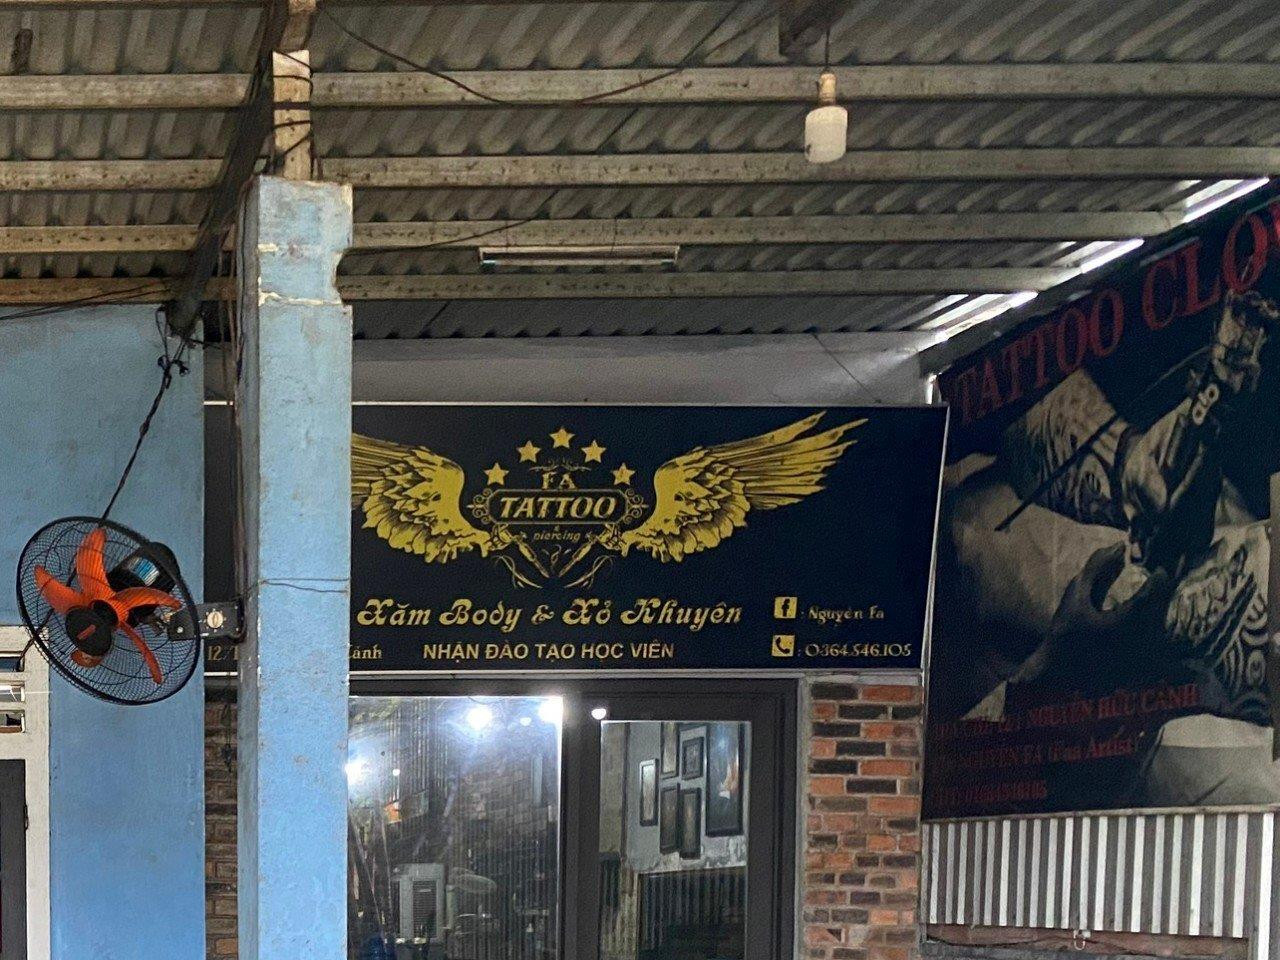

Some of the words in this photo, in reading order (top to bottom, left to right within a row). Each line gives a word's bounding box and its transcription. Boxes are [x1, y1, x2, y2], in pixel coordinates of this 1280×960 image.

[954, 288, 1124, 424] TATTOO
[541, 471, 577, 489] FA
[500, 496, 617, 519] TATTOO
[532, 529, 582, 542] piercing
[356, 598, 432, 626] Xăm
[438, 598, 523, 633] Body
[530, 604, 555, 625] &
[562, 597, 612, 625] Xỏ
[620, 597, 743, 632] Khuyên
[349, 643, 383, 660] ảnh
[485, 640, 529, 660] ĐÀO
[534, 643, 576, 662] TẠO
[581, 643, 624, 663] HỌC
[630, 639, 675, 659] VIÊN
